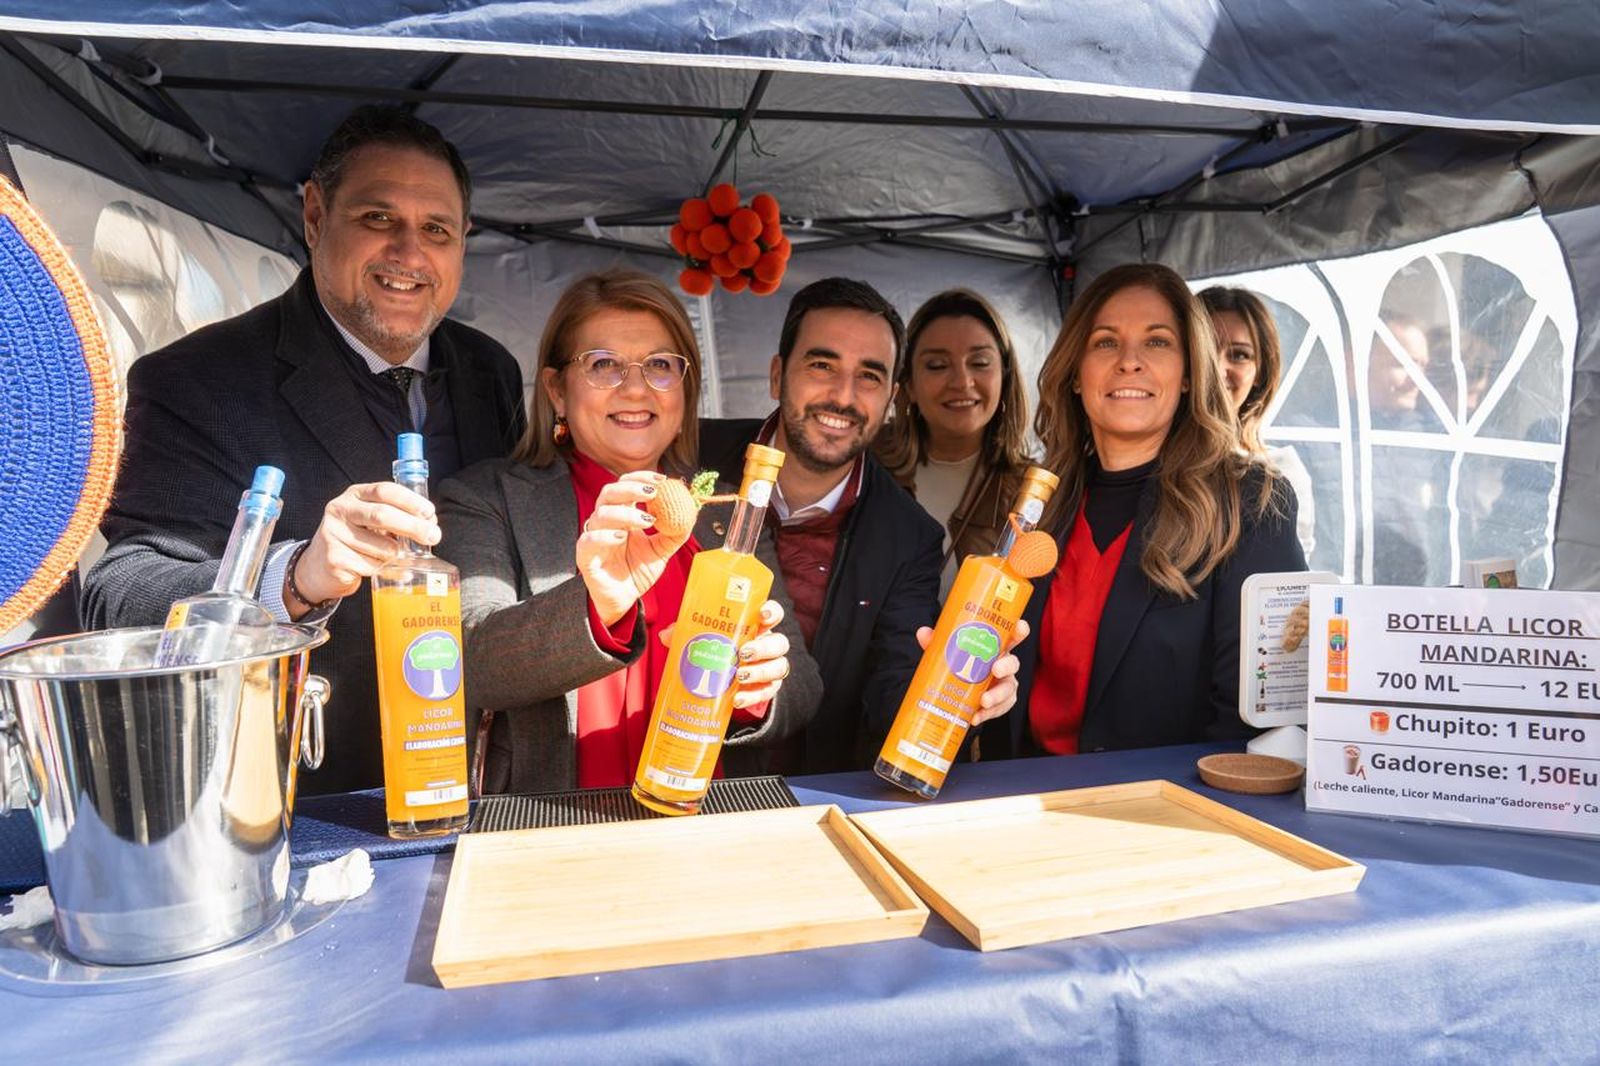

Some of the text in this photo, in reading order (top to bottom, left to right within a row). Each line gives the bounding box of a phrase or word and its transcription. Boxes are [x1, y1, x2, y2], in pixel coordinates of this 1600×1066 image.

[430, 601, 442, 612] EL
[719, 606, 731, 619] EL
[992, 600, 1003, 612] EL
[1387, 613, 1584, 636] BOTELLA LICOR
[1421, 644, 1587, 668] MANDARINA:
[1377, 672, 1417, 690] 700
[1425, 674, 1460, 692] ML
[1540, 680, 1568, 698] 12
[1396, 714, 1586, 742] Chupito: 1 Euro
[1371, 753, 1508, 780] Gadorense:
[1313, 781, 1349, 792] (Leche
[1351, 783, 1398, 797] caliente,
[1401, 788, 1429, 799] Licor
[1573, 804, 1581, 814] y
